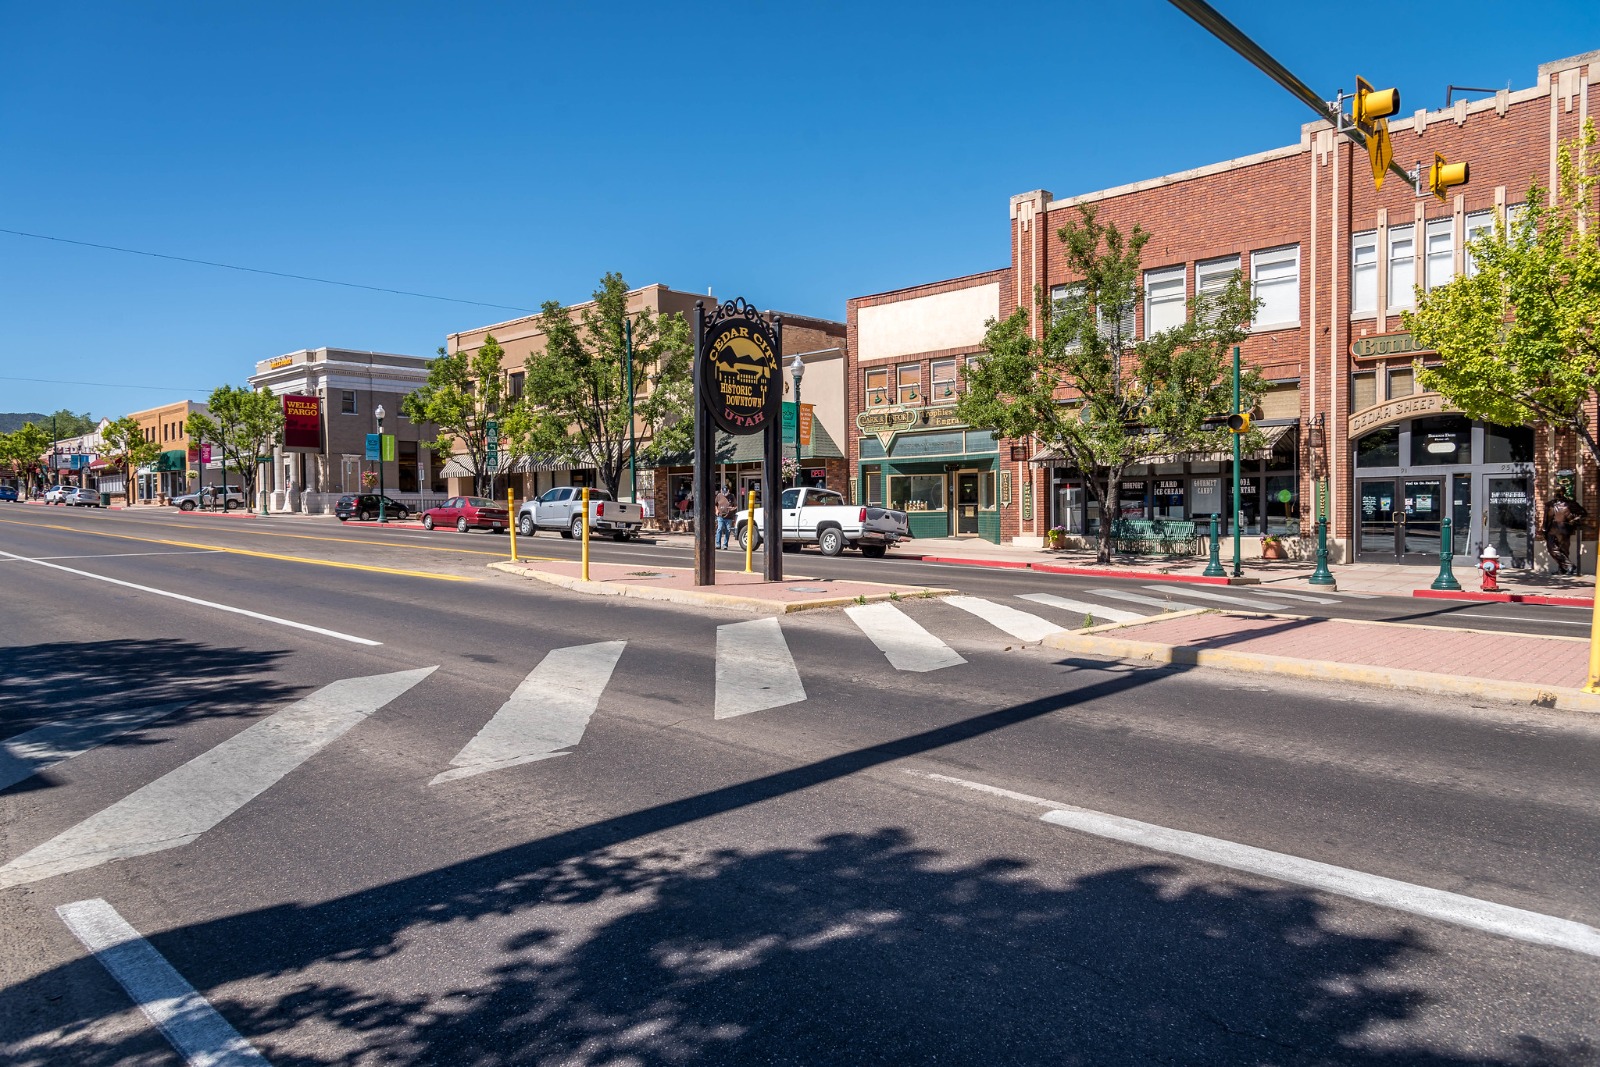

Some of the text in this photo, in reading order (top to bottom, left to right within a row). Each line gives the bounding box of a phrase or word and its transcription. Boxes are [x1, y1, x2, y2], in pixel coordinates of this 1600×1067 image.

[709, 327, 778, 370] CEDAR CITY
[1360, 339, 1424, 356] BULLO
[720, 382, 752, 396] HISTORIC
[286, 401, 318, 409] WELLS
[726, 394, 762, 408] DOWNTOWN
[724, 408, 765, 427] UTAH
[1353, 398, 1436, 430] CEDAR SHEEP
